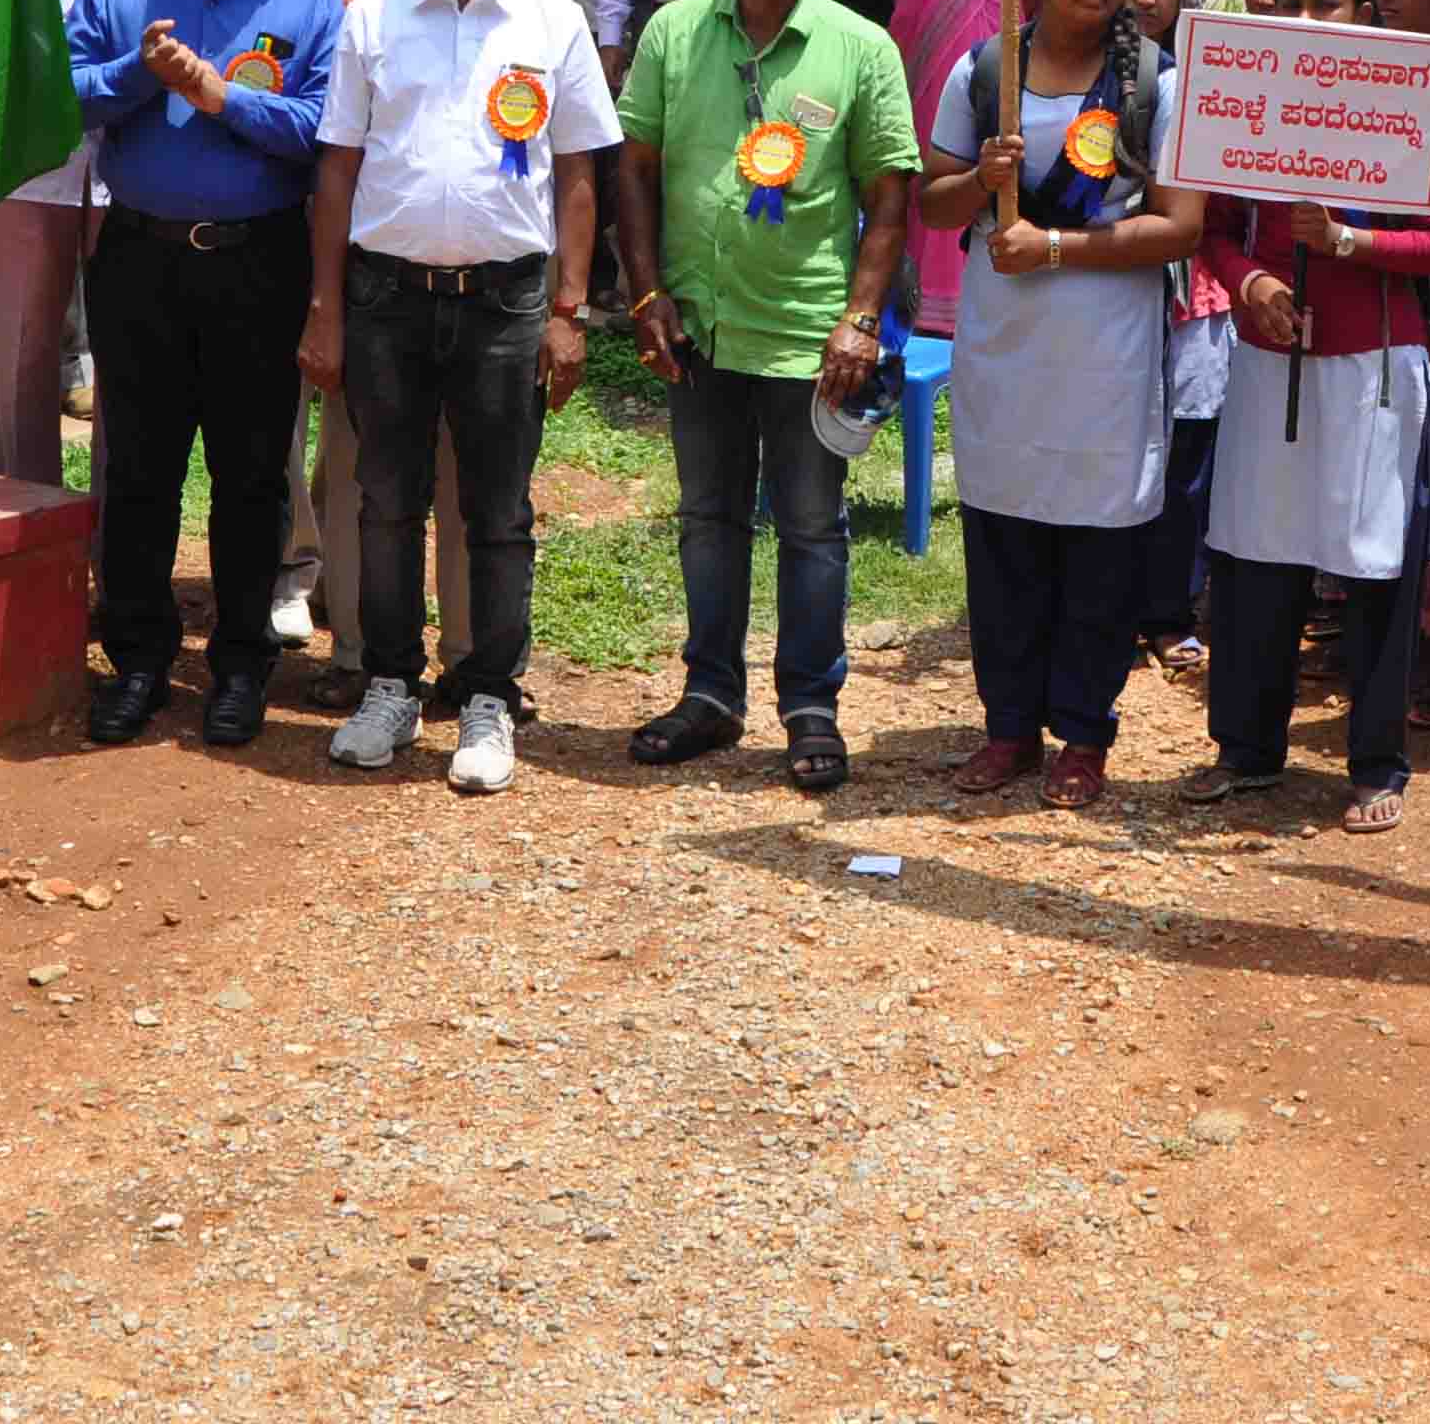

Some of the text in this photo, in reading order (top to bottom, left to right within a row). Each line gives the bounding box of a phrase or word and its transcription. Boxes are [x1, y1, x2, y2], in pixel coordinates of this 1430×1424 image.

[1201, 41, 1280, 74] ಮಲಗಿ
[1197, 89, 1427, 149] ಸೊಳ್ಳೆ ಪರದೆಯನ್ನು
[1221, 145, 1389, 185] ಉಪಯೋಗಿಸಿ
